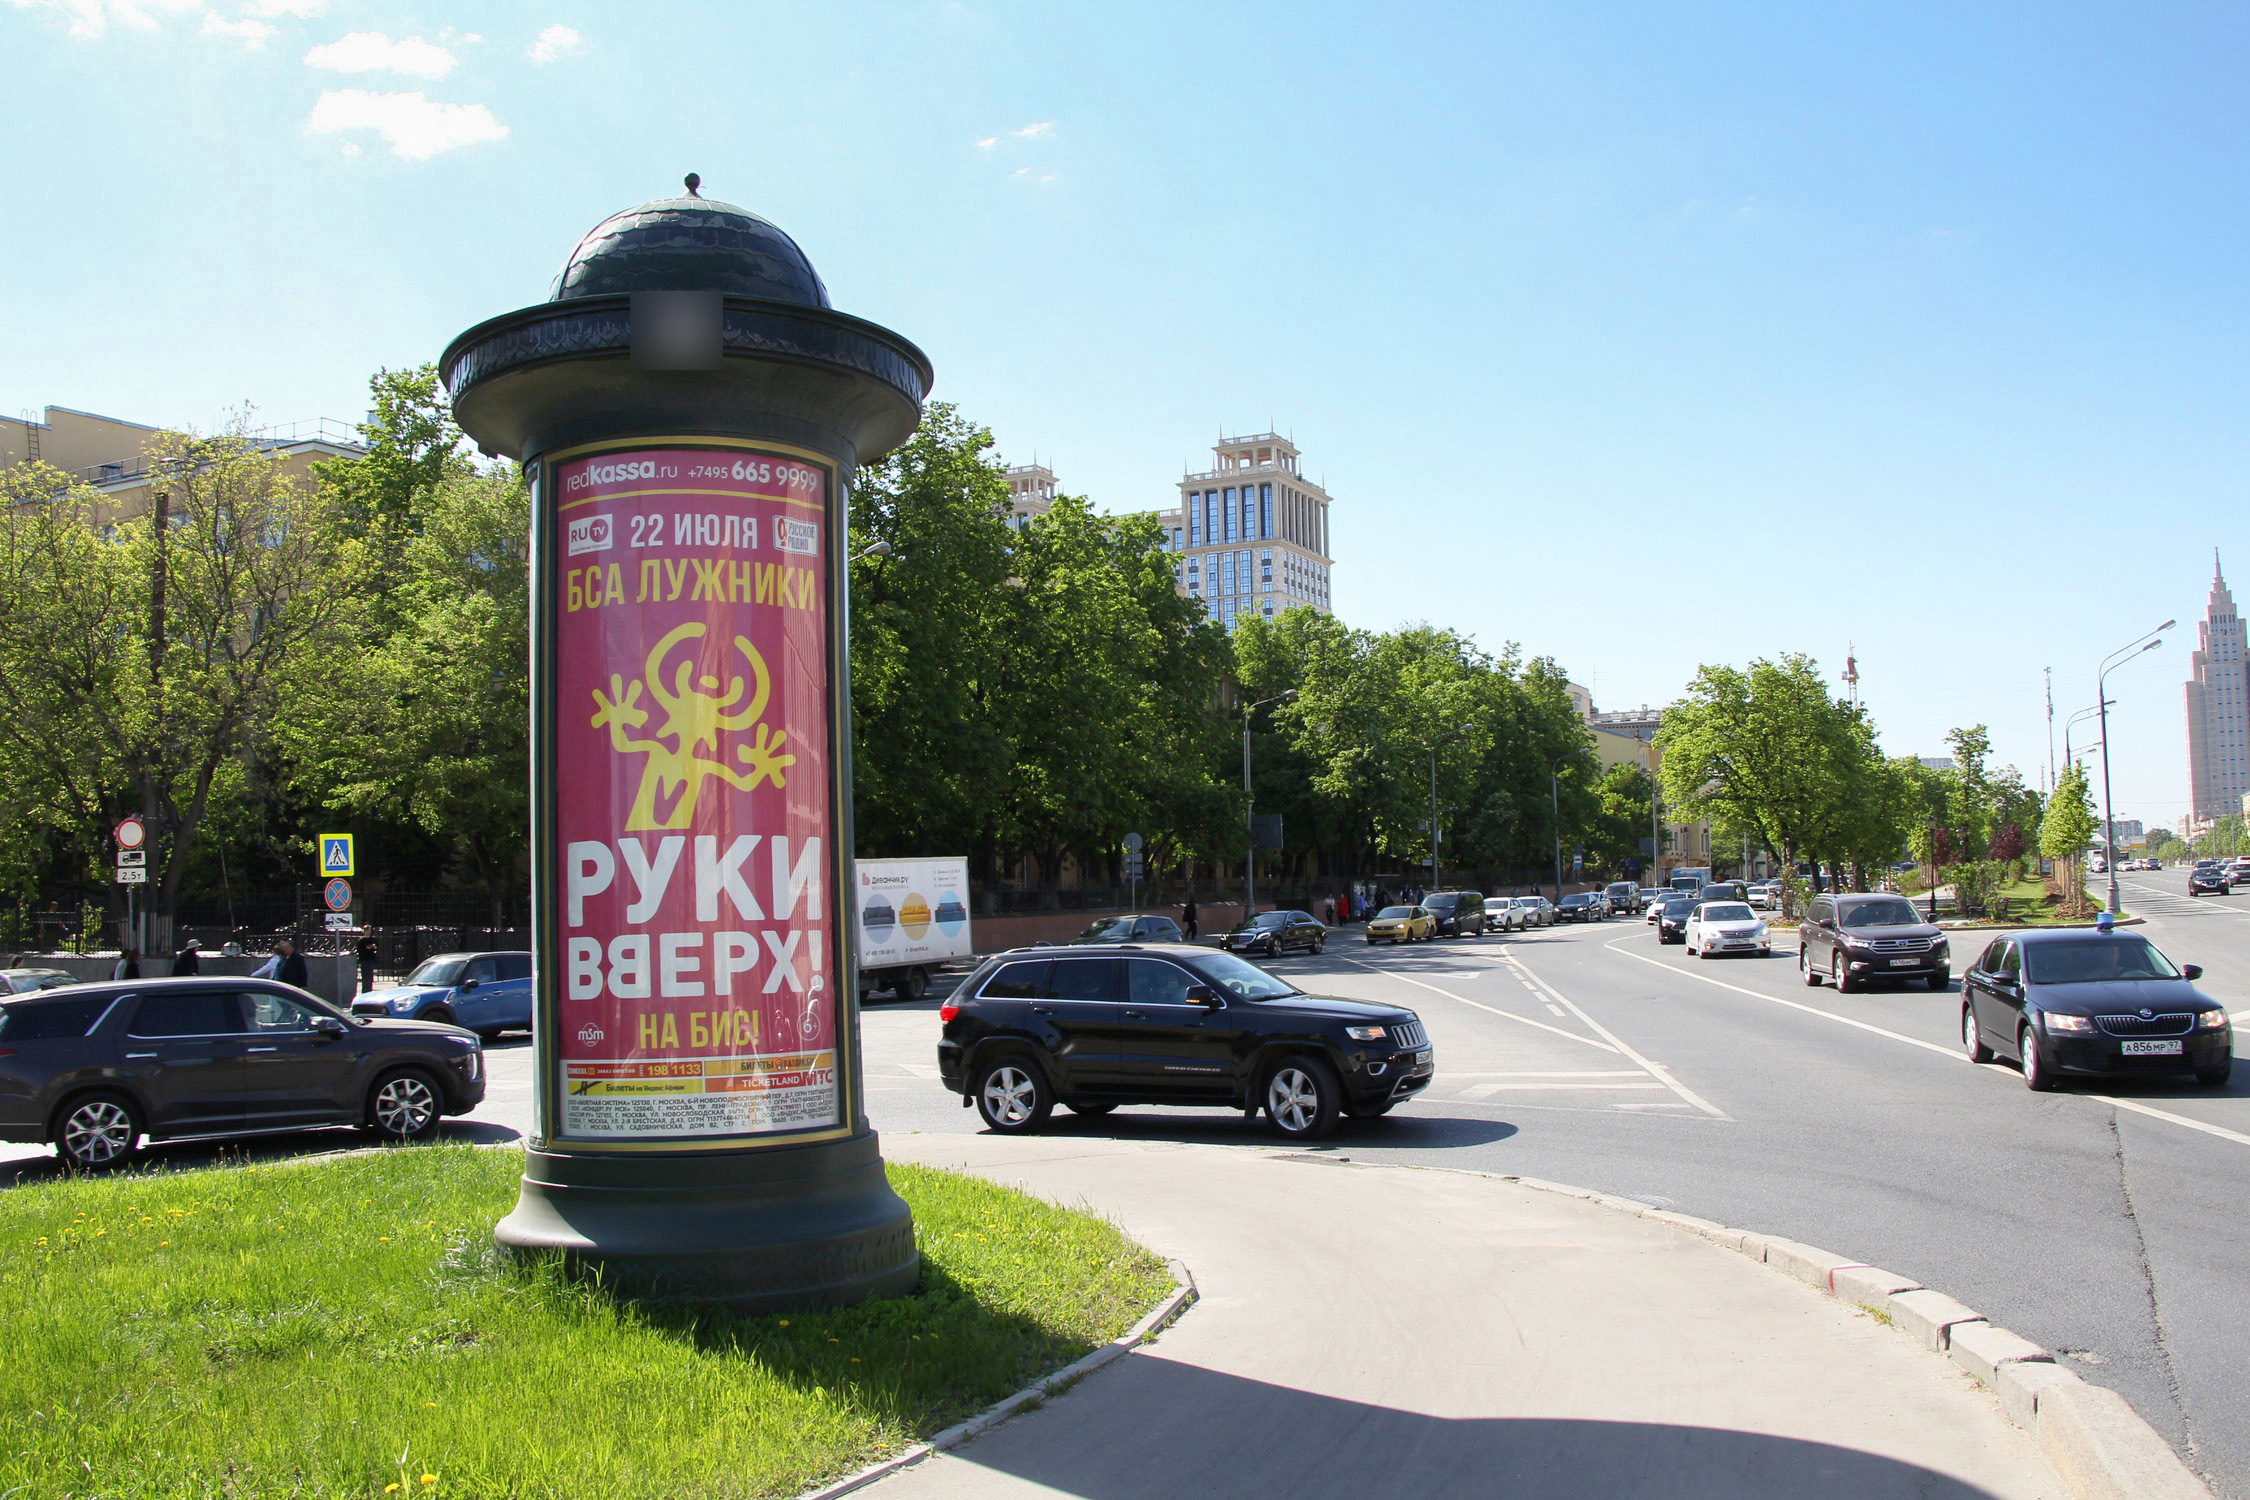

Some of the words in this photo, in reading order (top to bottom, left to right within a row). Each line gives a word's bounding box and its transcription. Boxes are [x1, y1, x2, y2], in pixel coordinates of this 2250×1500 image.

[566, 461, 678, 492] redkassa.ru
[687, 466, 728, 479] +7495
[731, 461, 770, 483] 665
[775, 466, 817, 492] 9999
[631, 514, 664, 548] 22
[674, 513, 758, 549] ИЮЛЯ
[788, 522, 815, 539] РУССКОЕ
[787, 536, 809, 550] РАДИО
[567, 562, 625, 612] БСА
[636, 558, 816, 612] ЛУЖНИКИ
[567, 834, 823, 928] РУКИ
[568, 930, 824, 1000] ВВЕРХ!
[640, 1013, 680, 1049] НА
[690, 1010, 760, 1047] БИС!
[802, 1021, 818, 1034] 6+
[647, 1065, 669, 1076] 198
[671, 1063, 702, 1075] 1133
[741, 1060, 774, 1071] БИЛЕТЫ
[606, 1084, 635, 1092] Билеты
[742, 1075, 800, 1088] TICKETLAND
